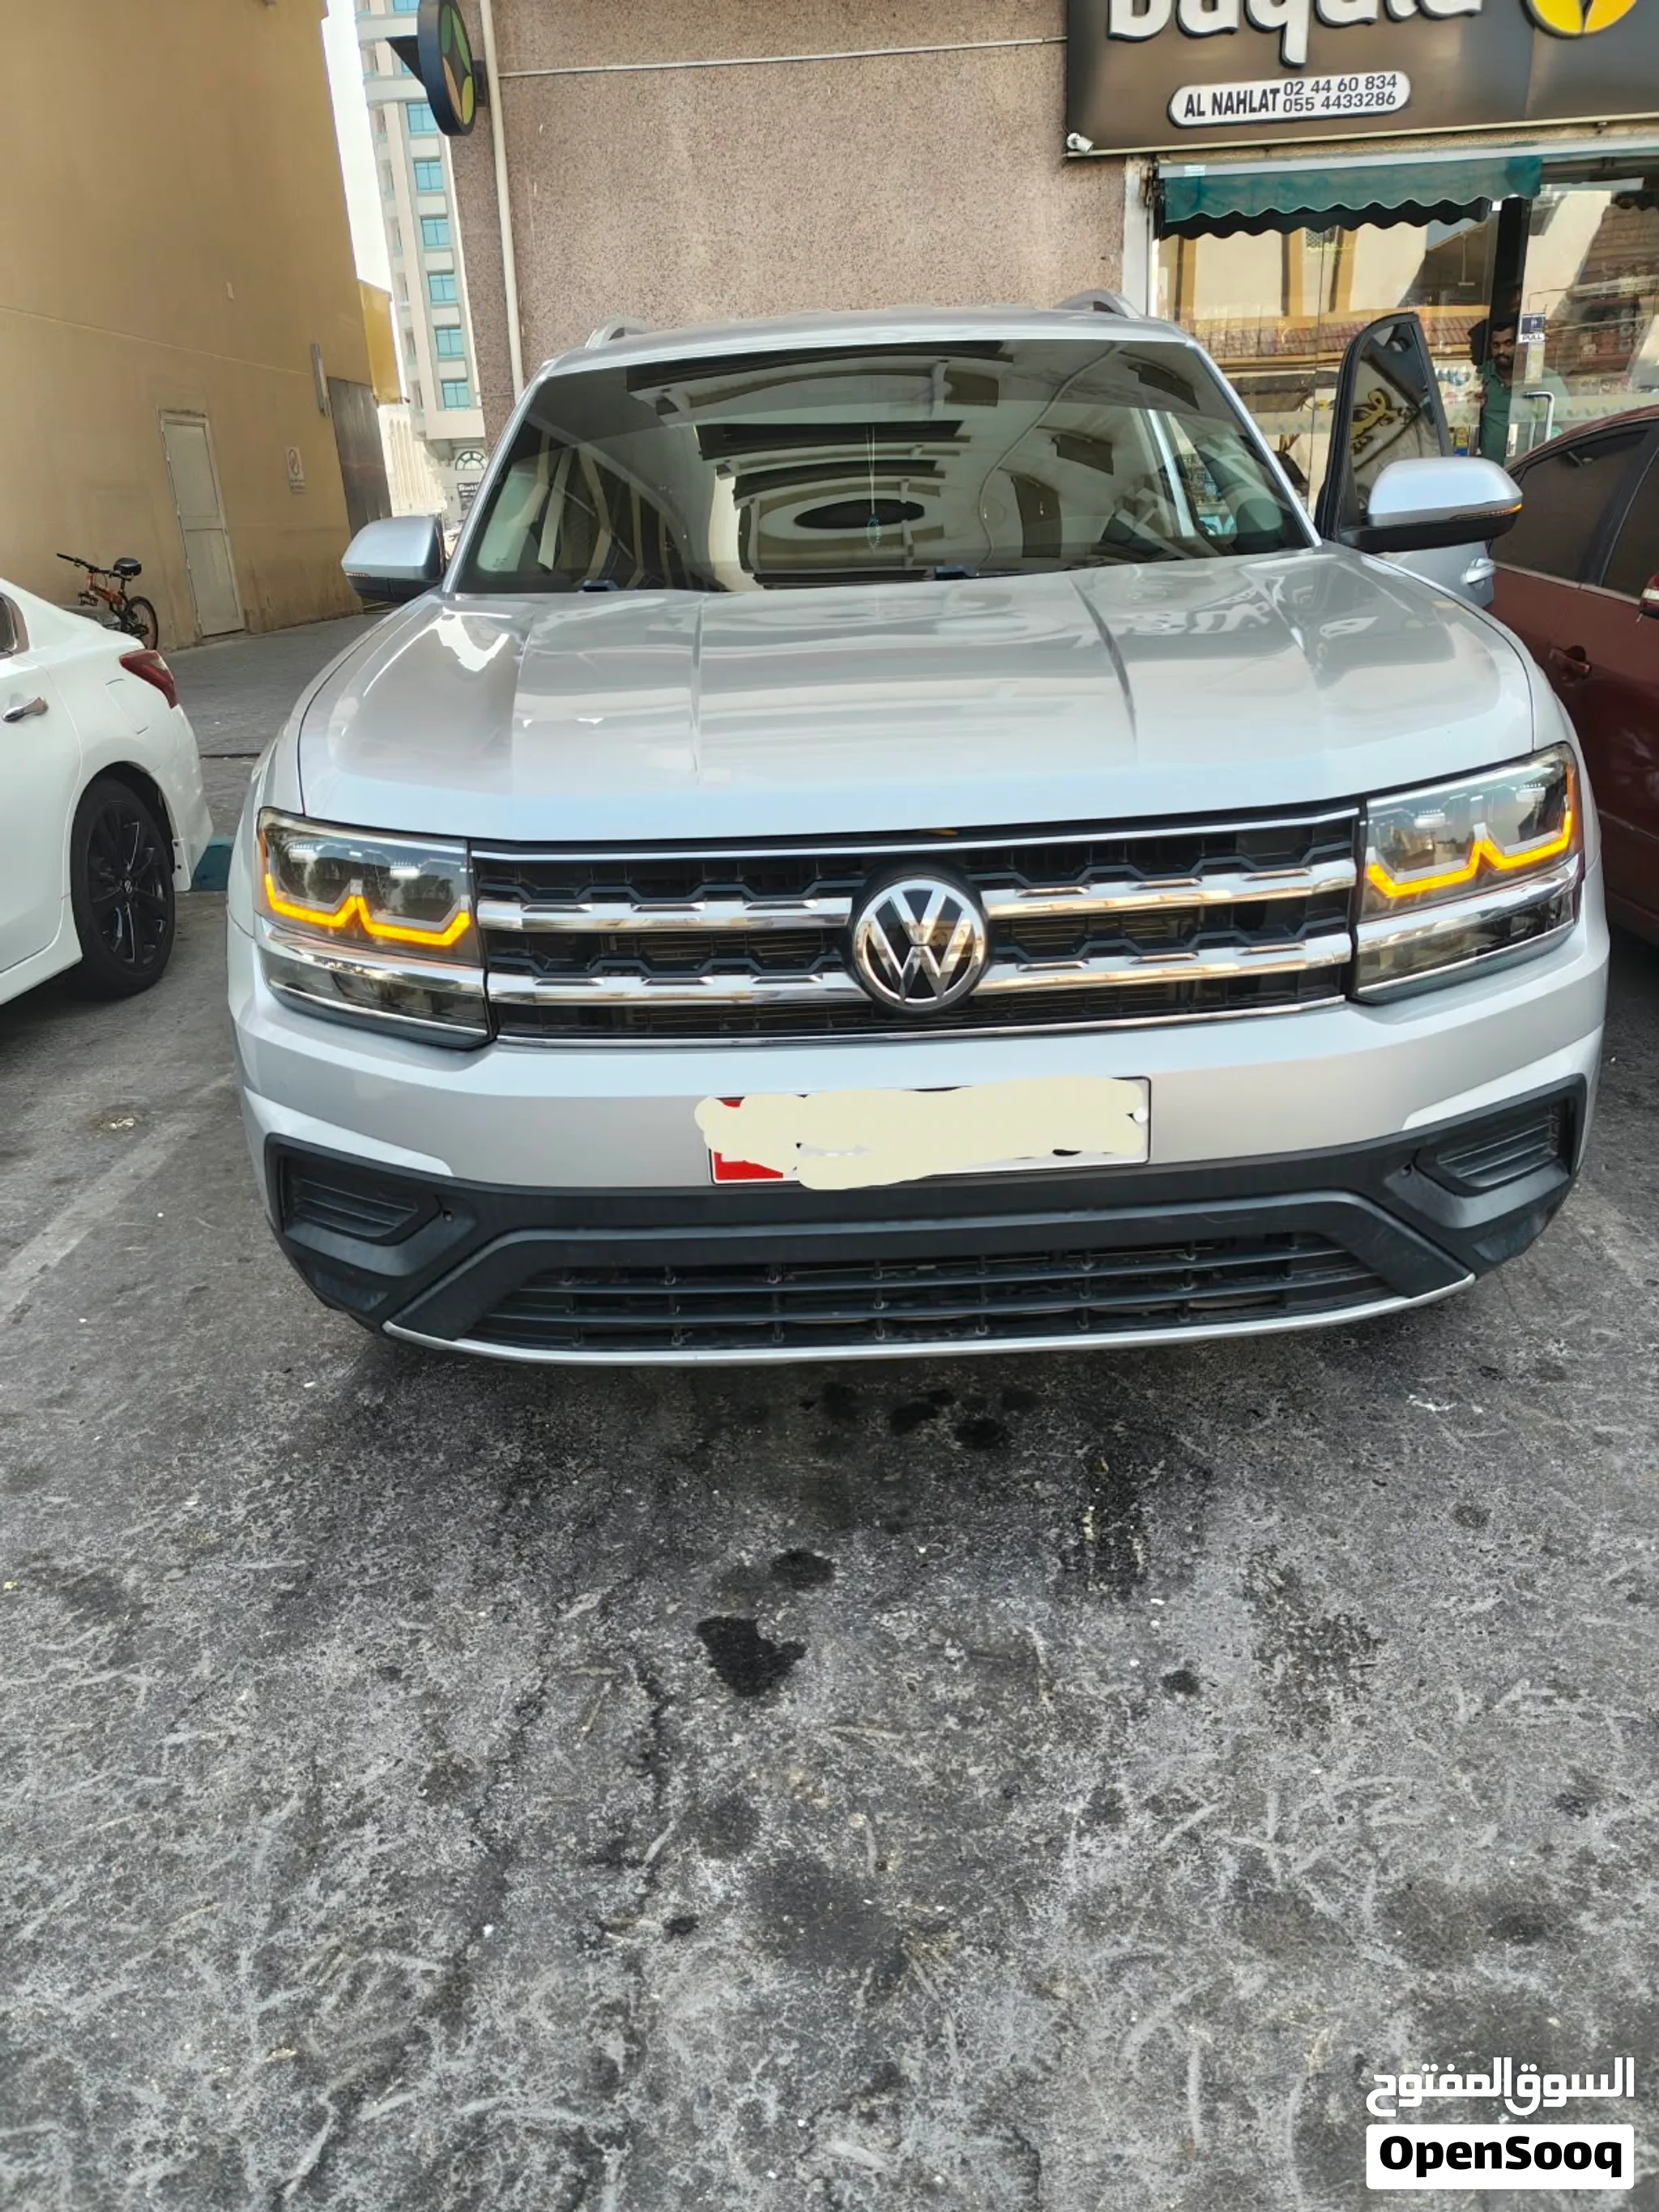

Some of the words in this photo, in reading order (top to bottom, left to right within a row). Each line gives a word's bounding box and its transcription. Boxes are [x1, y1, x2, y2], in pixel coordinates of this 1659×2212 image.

[1283, 80, 1304, 96] 02
[1311, 79, 1332, 94] 44
[1337, 77, 1358, 92] 60
[1364, 74, 1397, 90] 834
[1183, 93, 1205, 117] AL
[1212, 87, 1280, 115] NAHLAT
[1283, 96, 1315, 113] 055
[1321, 92, 1397, 110] 4433286
